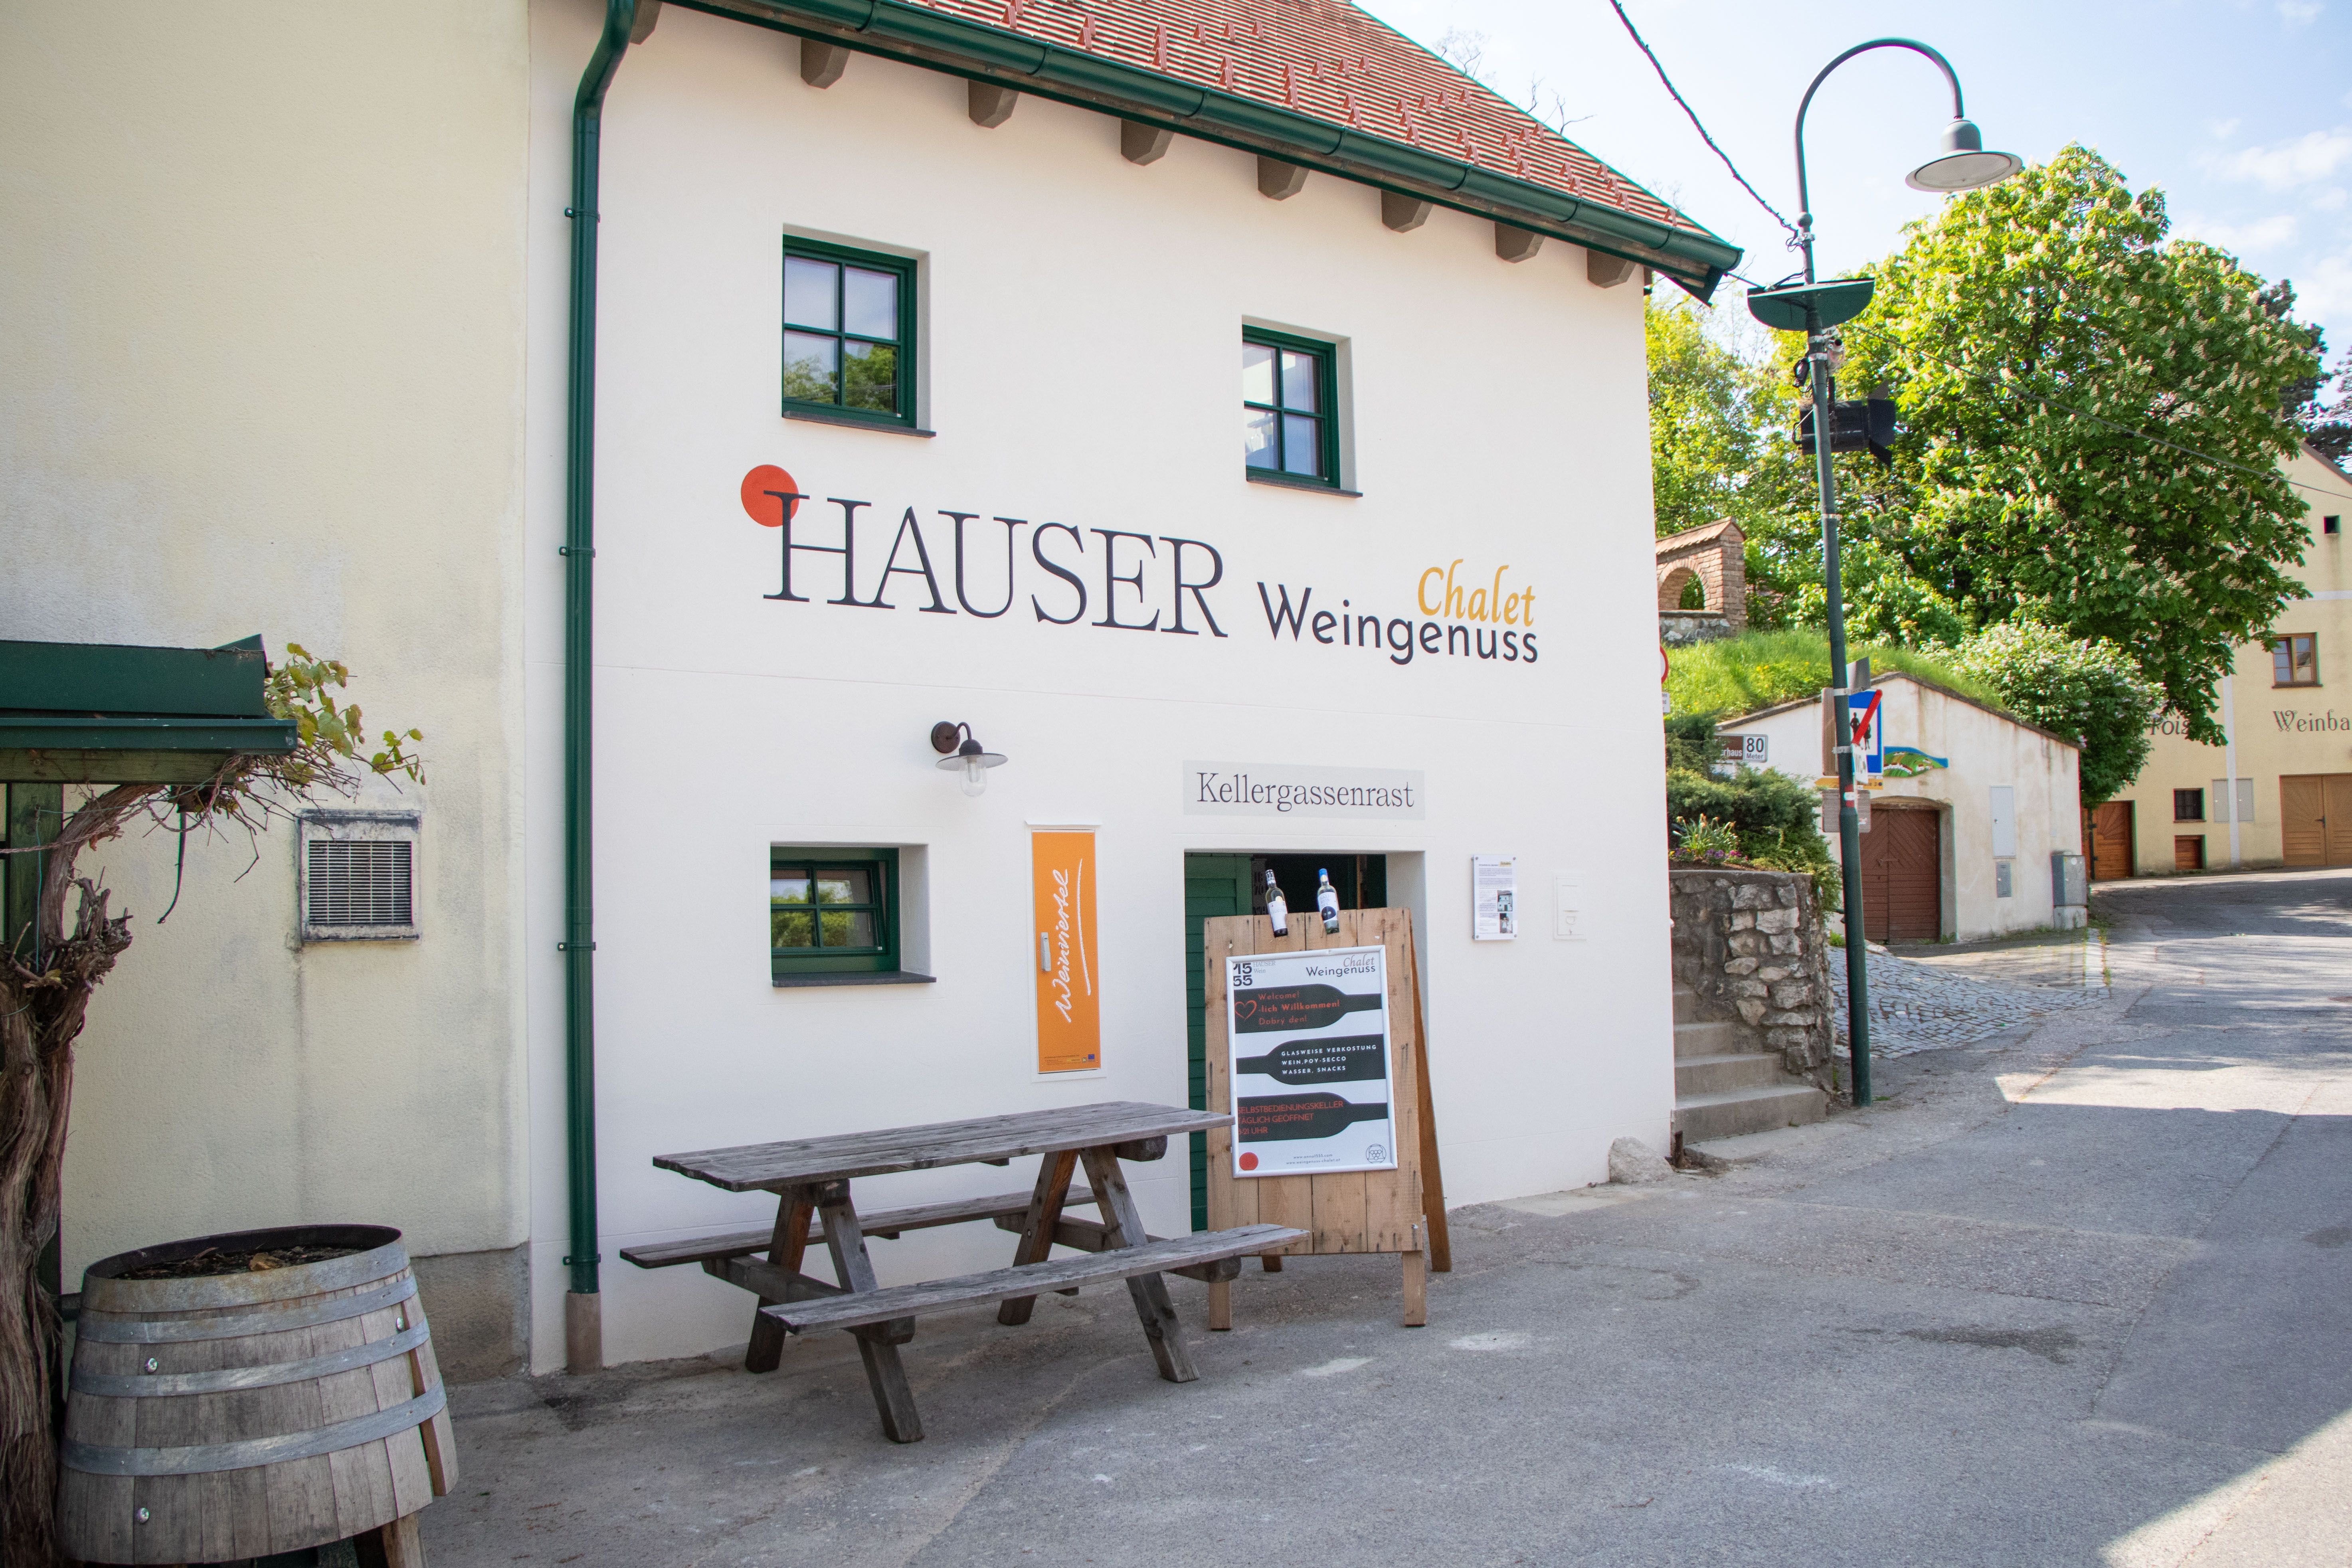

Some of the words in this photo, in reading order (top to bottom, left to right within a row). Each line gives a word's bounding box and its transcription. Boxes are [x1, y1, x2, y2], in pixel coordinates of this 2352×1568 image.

[763, 490, 1228, 638] HAUSER
[1418, 560, 1536, 627] Chalet
[1257, 582, 1537, 665] Weingenuss
[2273, 709, 2351, 732] Weinba
[1747, 738, 1764, 753] 80
[1197, 772, 1414, 812] Kellergassenrast
[1052, 868, 1072, 1023] Weinviertel
[1343, 953, 1375, 967] Chalet
[1233, 962, 1252, 975] 15
[1306, 965, 1376, 977] Weingenuss
[1234, 975, 1253, 987] 55
[1258, 991, 1300, 1000] Welcome!
[1281, 999, 1340, 1011] Willkommen!
[1258, 1017, 1285, 1025] Dobrý
[1289, 1015, 1307, 1024] den!
[1327, 1044, 1377, 1053] VERKOSTUNG
[1238, 1101, 1344, 1114] SELBSTBEDIENUNGSKELLER
[1238, 1116, 1270, 1124] TÄGLICH
[1272, 1113, 1314, 1123] GEÖFFNET
